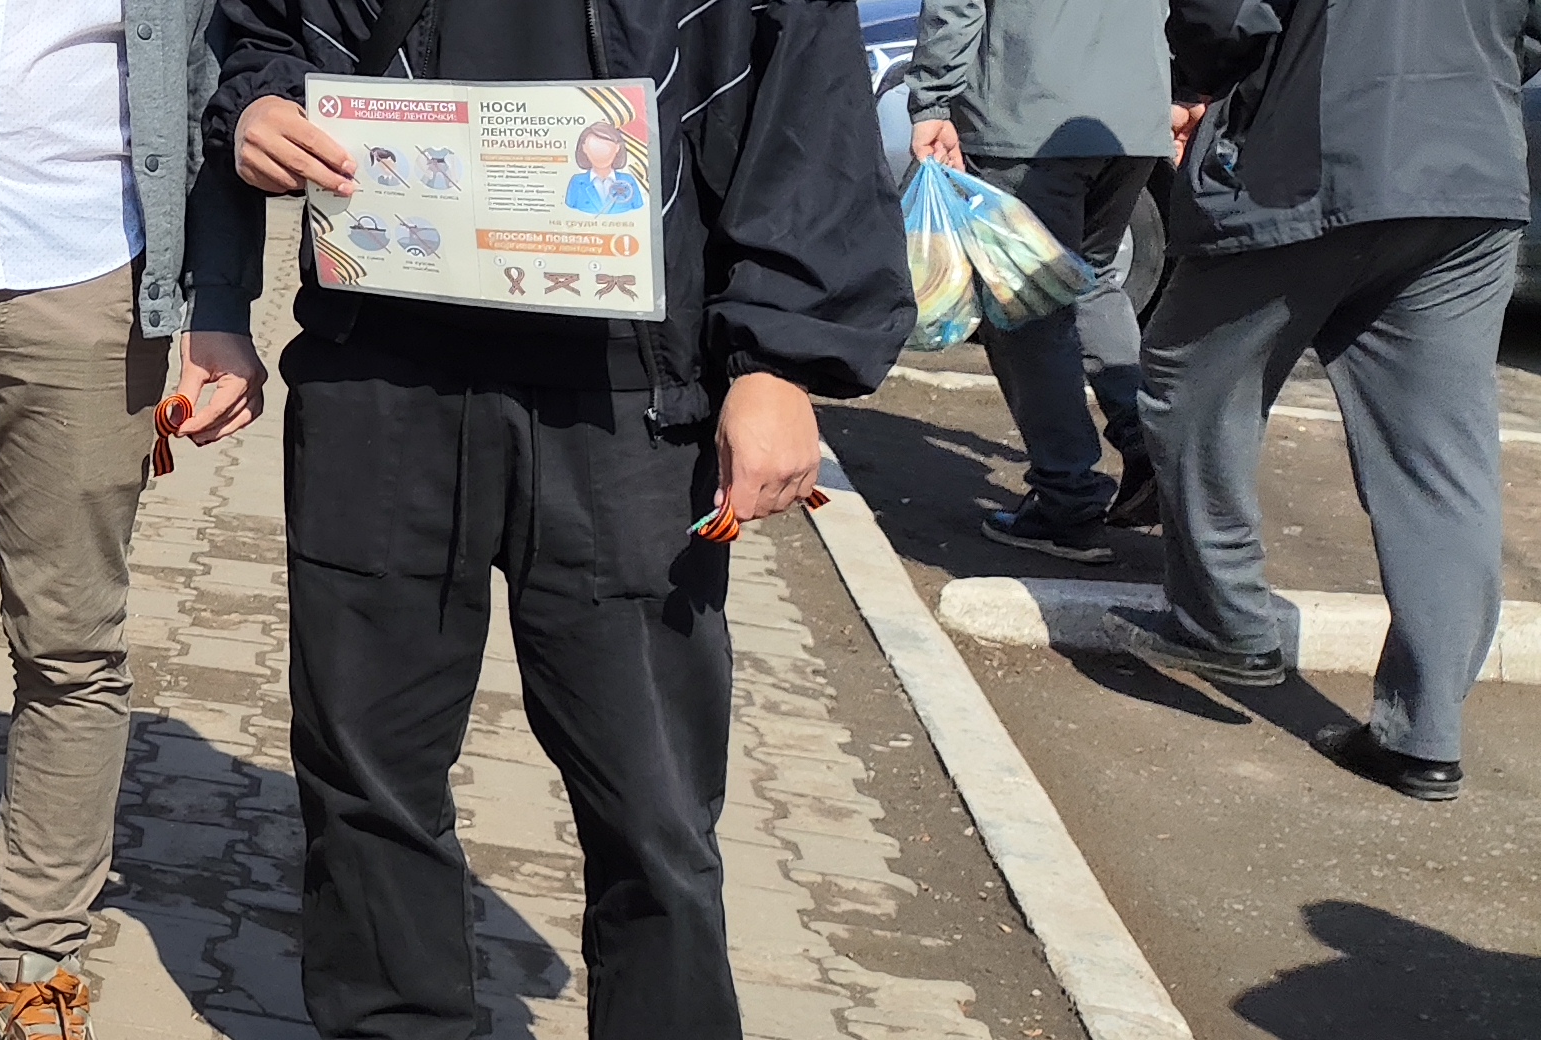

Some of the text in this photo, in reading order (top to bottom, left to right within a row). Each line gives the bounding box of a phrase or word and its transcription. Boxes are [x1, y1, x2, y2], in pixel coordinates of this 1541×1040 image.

[350, 98, 457, 112] НЕ ДОПУСКАЕТСЯ
[480, 101, 527, 113] НОСИ
[355, 110, 402, 120] НОШЕНИЕ
[480, 116, 586, 126] ГЕОРГИЕВСКУЮ
[480, 127, 550, 137] ЛЕНТОЧКУ
[481, 139, 568, 150] ПРАВИЛЬНО!
[487, 231, 604, 245] СПОСОБЫ ПОВЯЗАТЬ
